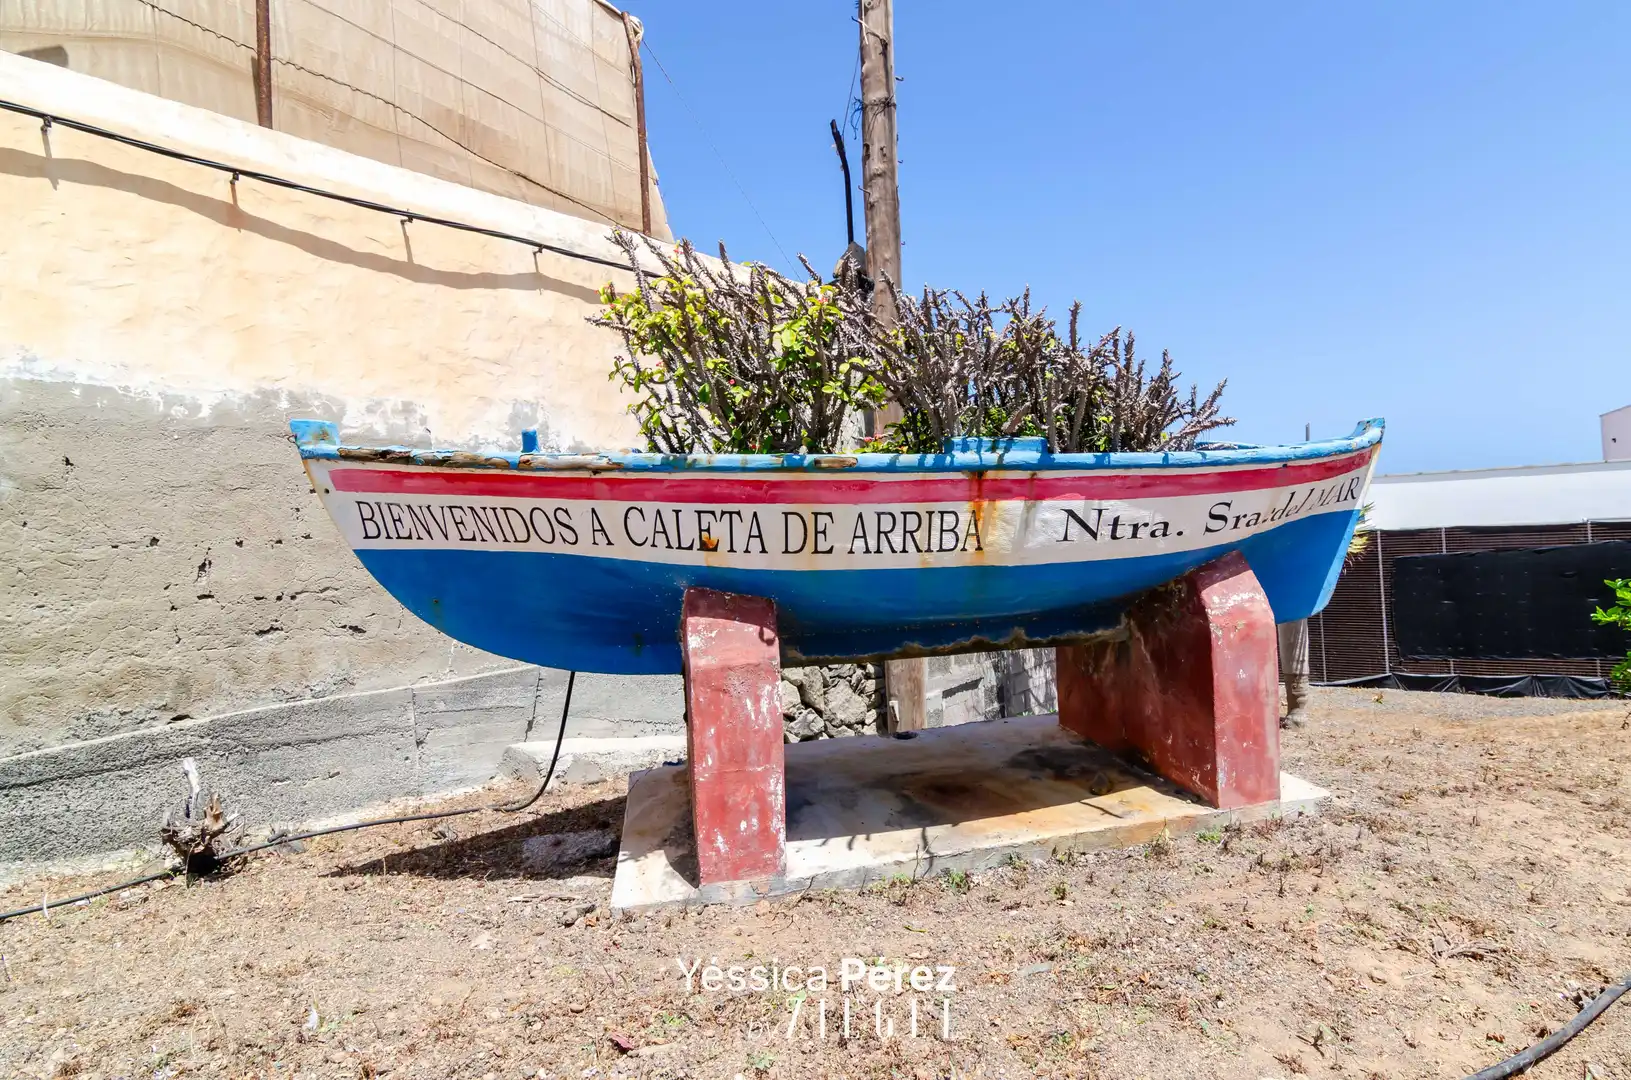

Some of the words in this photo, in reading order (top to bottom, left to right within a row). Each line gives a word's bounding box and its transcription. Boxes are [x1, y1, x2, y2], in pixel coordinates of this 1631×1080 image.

[354, 500, 579, 546] BIENVENIDOS
[591, 506, 615, 546] A
[623, 506, 769, 554] CALETA
[781, 511, 834, 555] DE
[847, 509, 984, 555] ARRIBA
[1055, 507, 1184, 542] Ntra.
[1269, 487, 1316, 522] del
[1308, 476, 1360, 511] MAR
